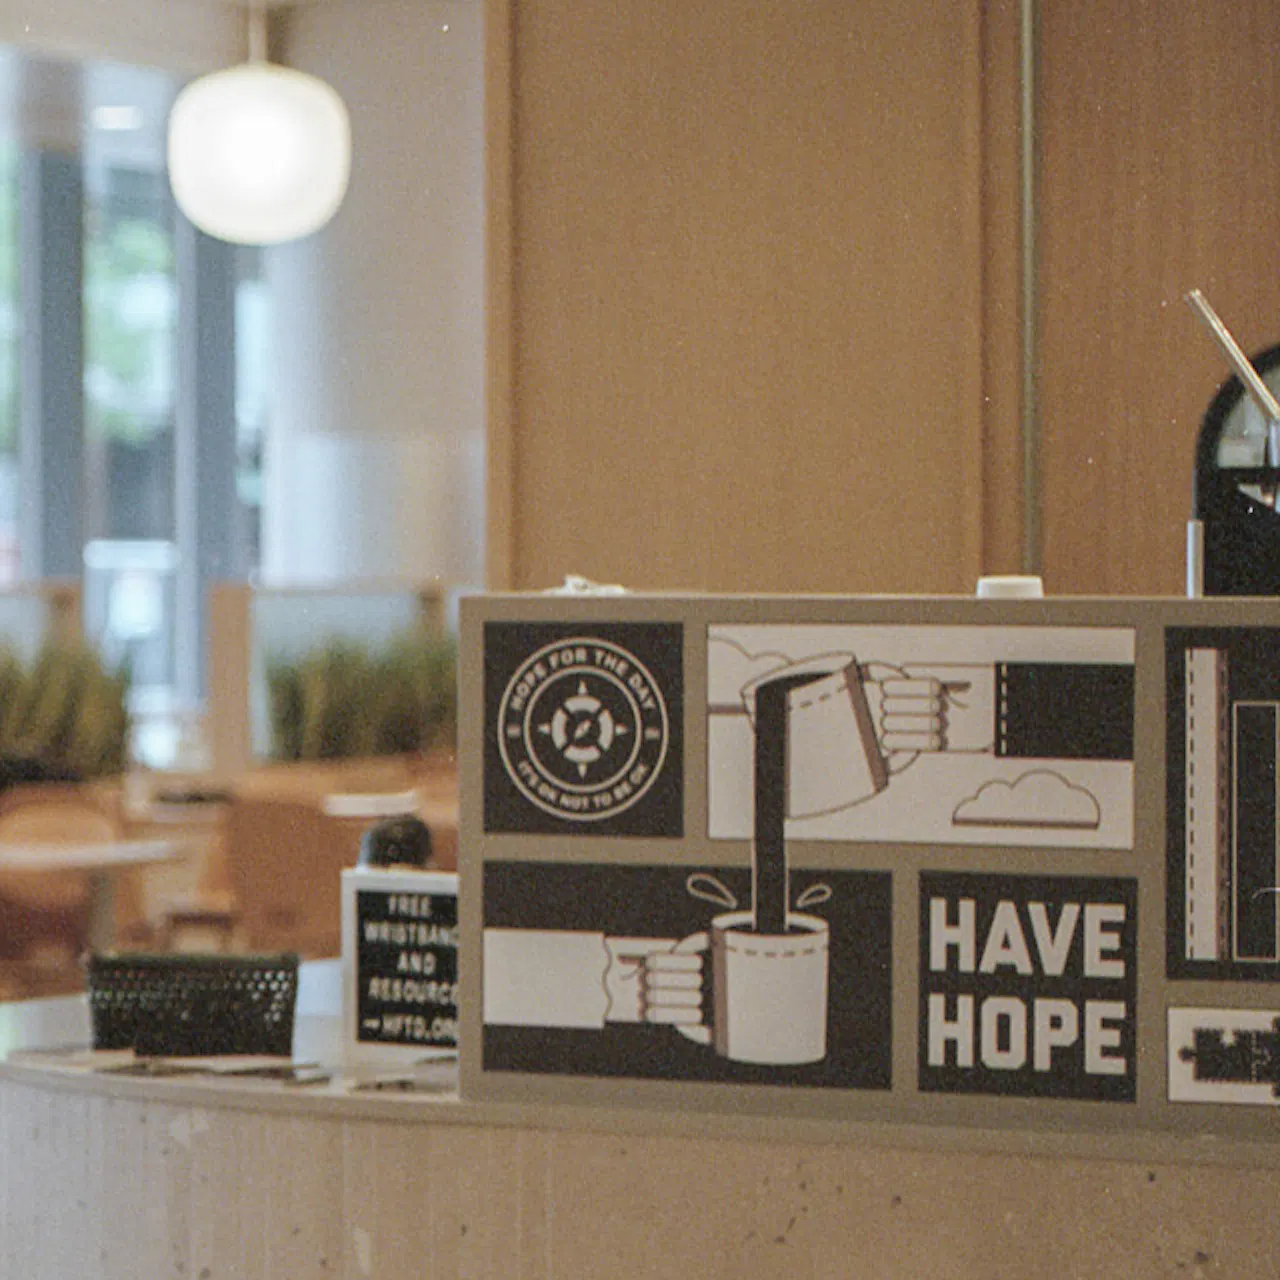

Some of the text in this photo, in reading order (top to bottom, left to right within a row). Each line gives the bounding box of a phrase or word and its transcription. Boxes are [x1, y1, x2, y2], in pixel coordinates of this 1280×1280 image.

[510, 647, 656, 711] HOPE FOR THE DAY
[388, 894, 430, 918] FREE
[929, 896, 1126, 979] HAVE
[397, 950, 437, 975] AND
[927, 992, 1126, 1075] HOPE
